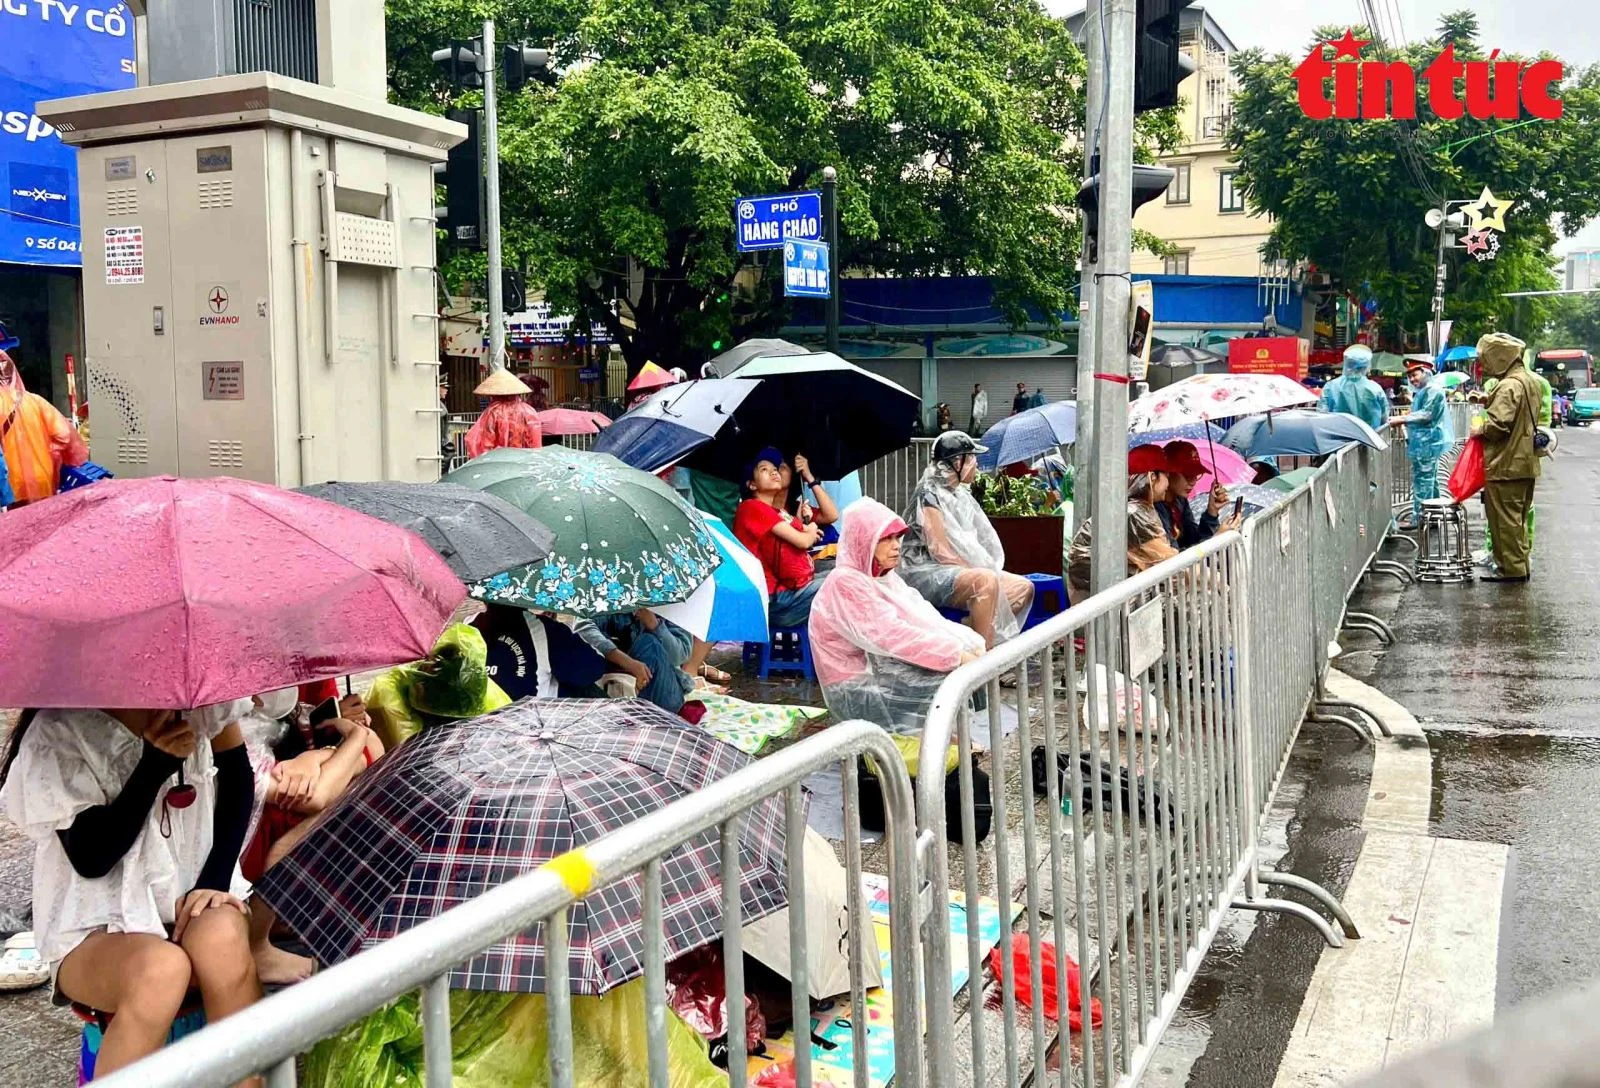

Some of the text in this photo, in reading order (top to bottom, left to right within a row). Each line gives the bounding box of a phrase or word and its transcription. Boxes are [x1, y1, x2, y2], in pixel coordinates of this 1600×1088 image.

[34, 0, 79, 26] TY
[85, 4, 126, 37] CỔ
[771, 197, 799, 213] PHỐ
[744, 214, 818, 241] HÀNG CHÁO
[37, 237, 57, 249] Số
[58, 240, 76, 251] 04
